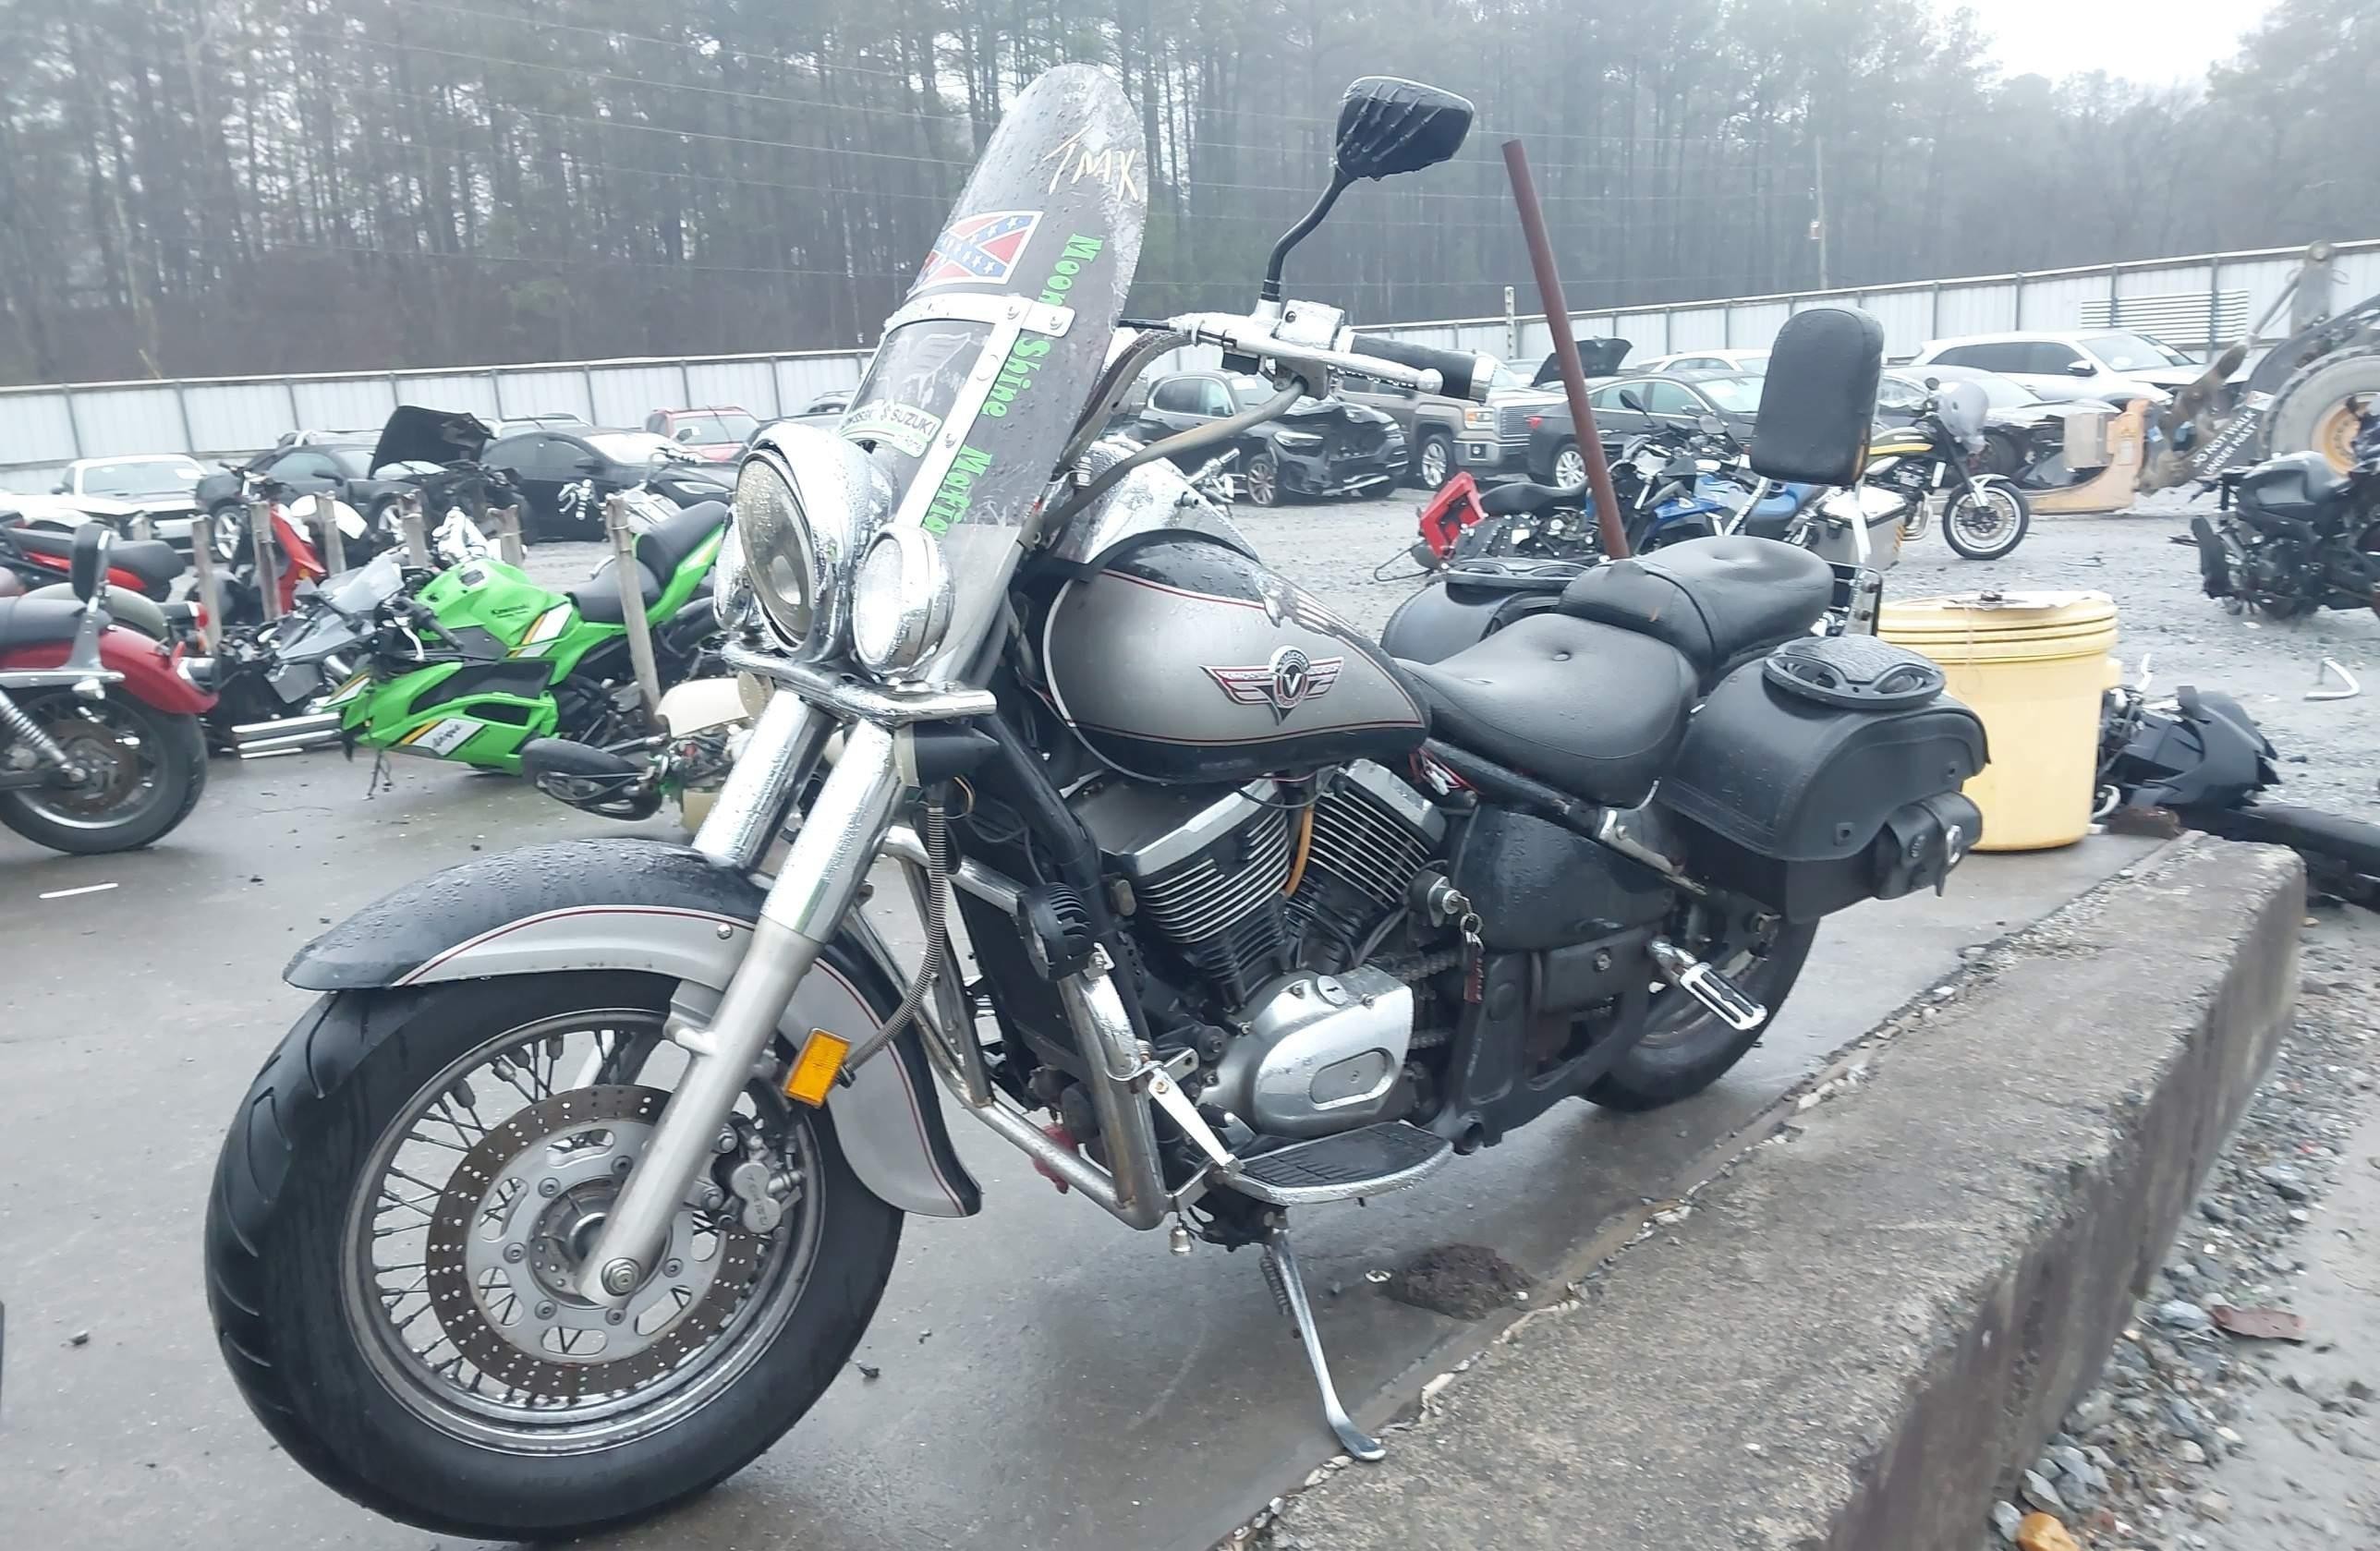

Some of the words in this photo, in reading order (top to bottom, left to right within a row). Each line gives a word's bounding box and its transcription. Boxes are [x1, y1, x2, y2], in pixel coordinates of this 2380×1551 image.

[1038, 233, 1103, 308] Moon
[979, 338, 1050, 418] Shine
[890, 408, 937, 436] SUZUKI
[2204, 434, 2228, 454] NOT
[2224, 410, 2257, 435] WALK
[2204, 446, 2236, 475] UNDER
[2231, 422, 2258, 447] MAST
[1283, 673, 1304, 696] V
